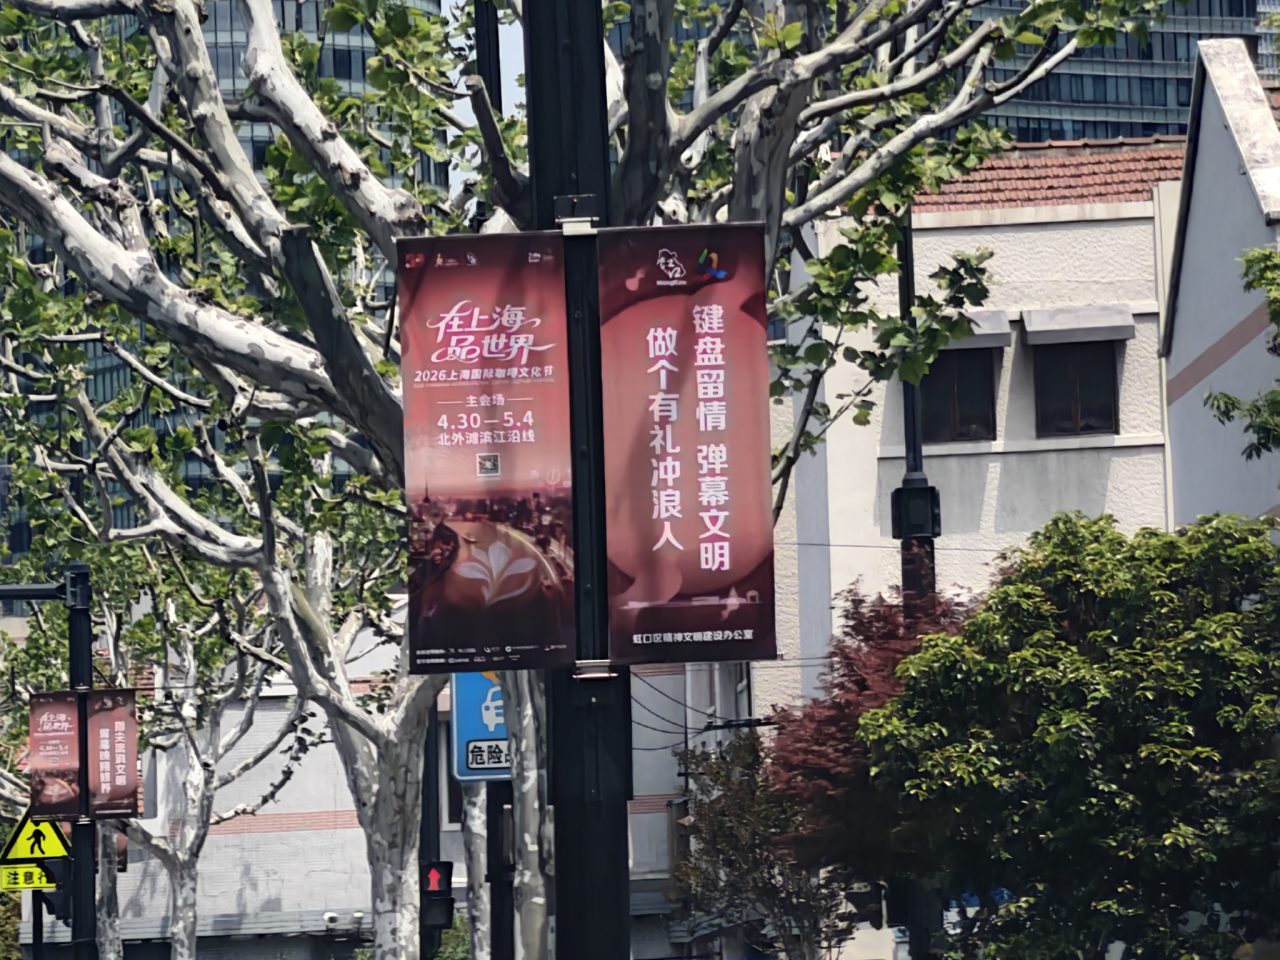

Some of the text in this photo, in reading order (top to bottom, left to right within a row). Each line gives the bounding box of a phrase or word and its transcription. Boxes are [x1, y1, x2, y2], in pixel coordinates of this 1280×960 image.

[426, 299, 542, 343] 在上海
[431, 333, 558, 365] 品世界
[465, 393, 505, 408] 主会场
[646, 327, 684, 552] 做个有礼冲浪人
[692, 304, 731, 572] 键盘留情 弹幕文明
